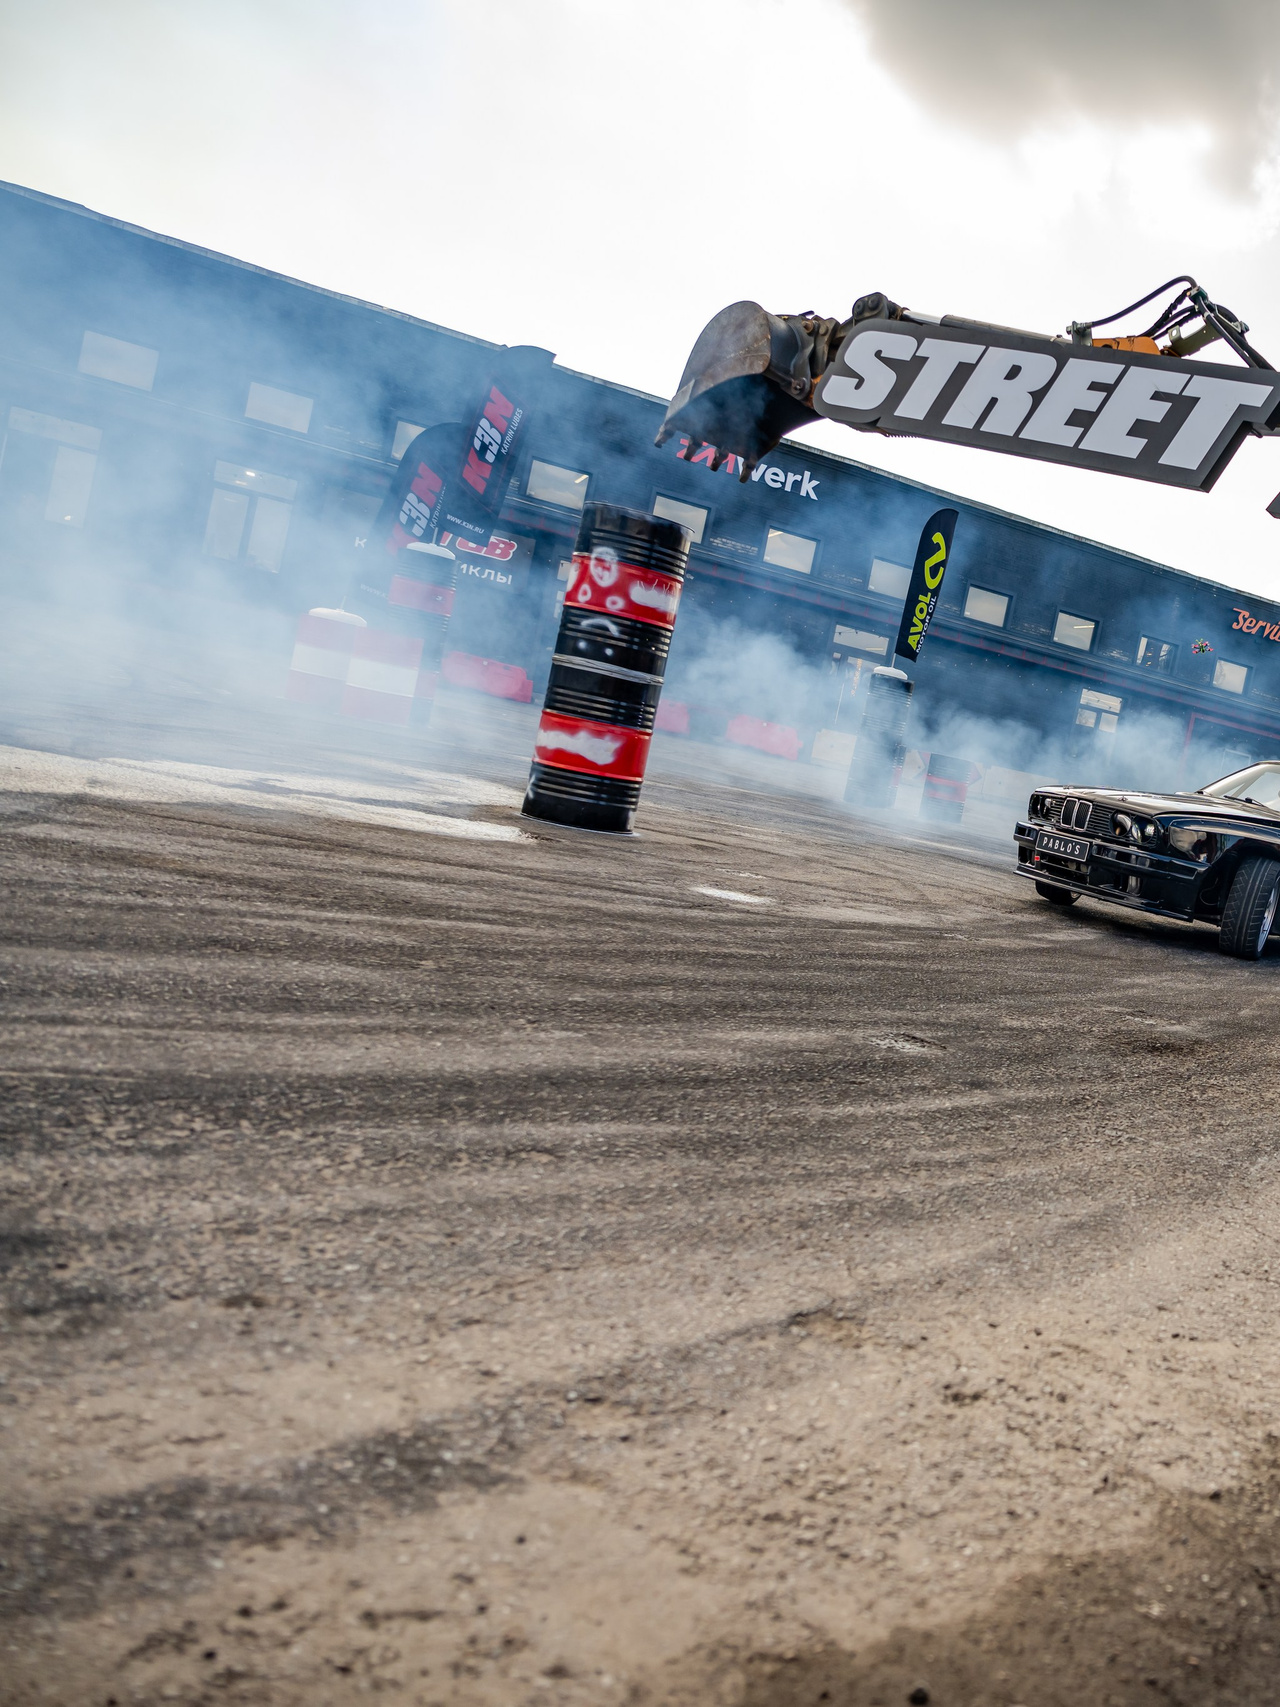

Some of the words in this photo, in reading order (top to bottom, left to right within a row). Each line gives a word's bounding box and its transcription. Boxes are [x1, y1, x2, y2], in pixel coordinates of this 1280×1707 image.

[821, 330, 1274, 471] STREET
[501, 428, 514, 455] KATRIN
[509, 408, 523, 430] LUBES
[908, 592, 931, 650] AVOL
[916, 615, 930, 653] MOTOR
[928, 596, 937, 613] OIL
[1042, 836, 1081, 855] PABLO'S
